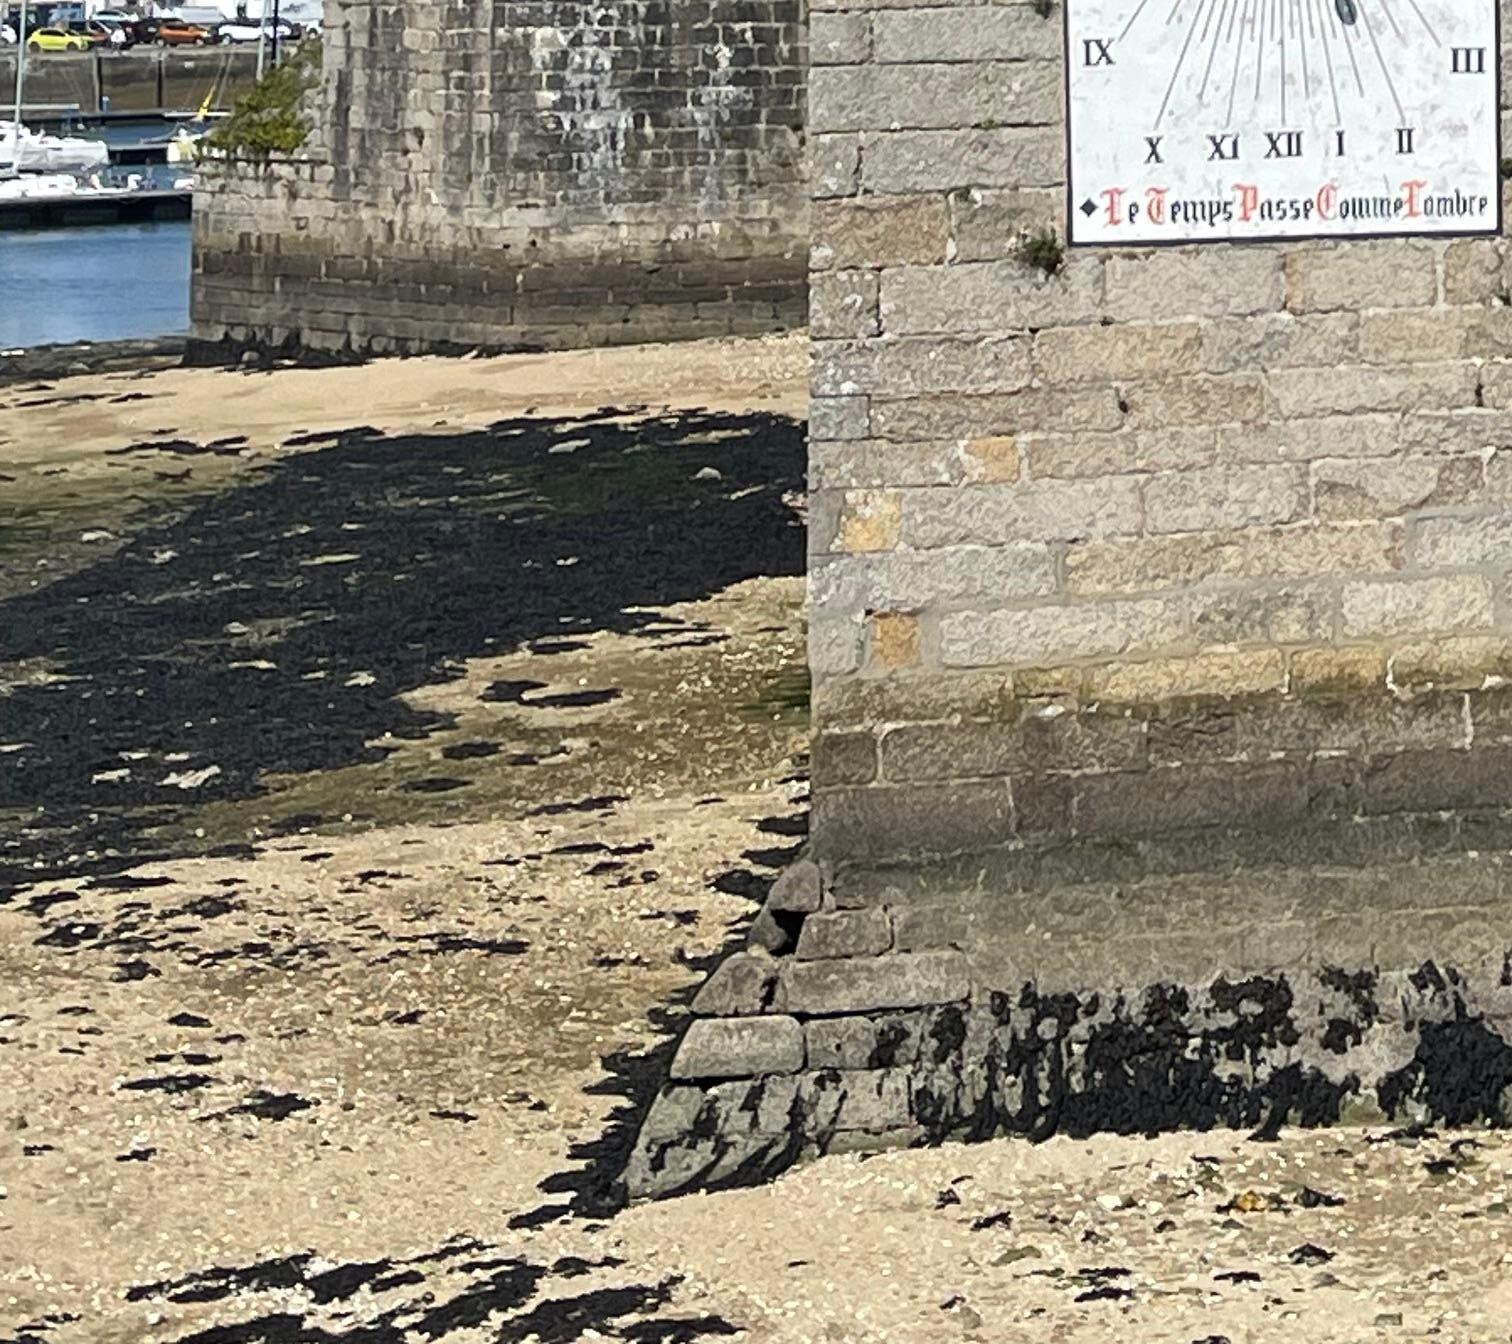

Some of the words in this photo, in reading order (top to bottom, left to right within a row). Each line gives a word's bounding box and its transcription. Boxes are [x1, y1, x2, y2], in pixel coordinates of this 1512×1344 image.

[1082, 38, 1116, 66] IX
[1450, 47, 1487, 74] III
[1144, 135, 1164, 163] X
[1206, 133, 1240, 161] XI
[1263, 130, 1304, 158] XII
[1335, 130, 1345, 157] I
[1394, 127, 1415, 154] II
[1145, 185, 1233, 227] Temps
[1231, 183, 1314, 222] Passe
[1316, 178, 1404, 221] Comme
